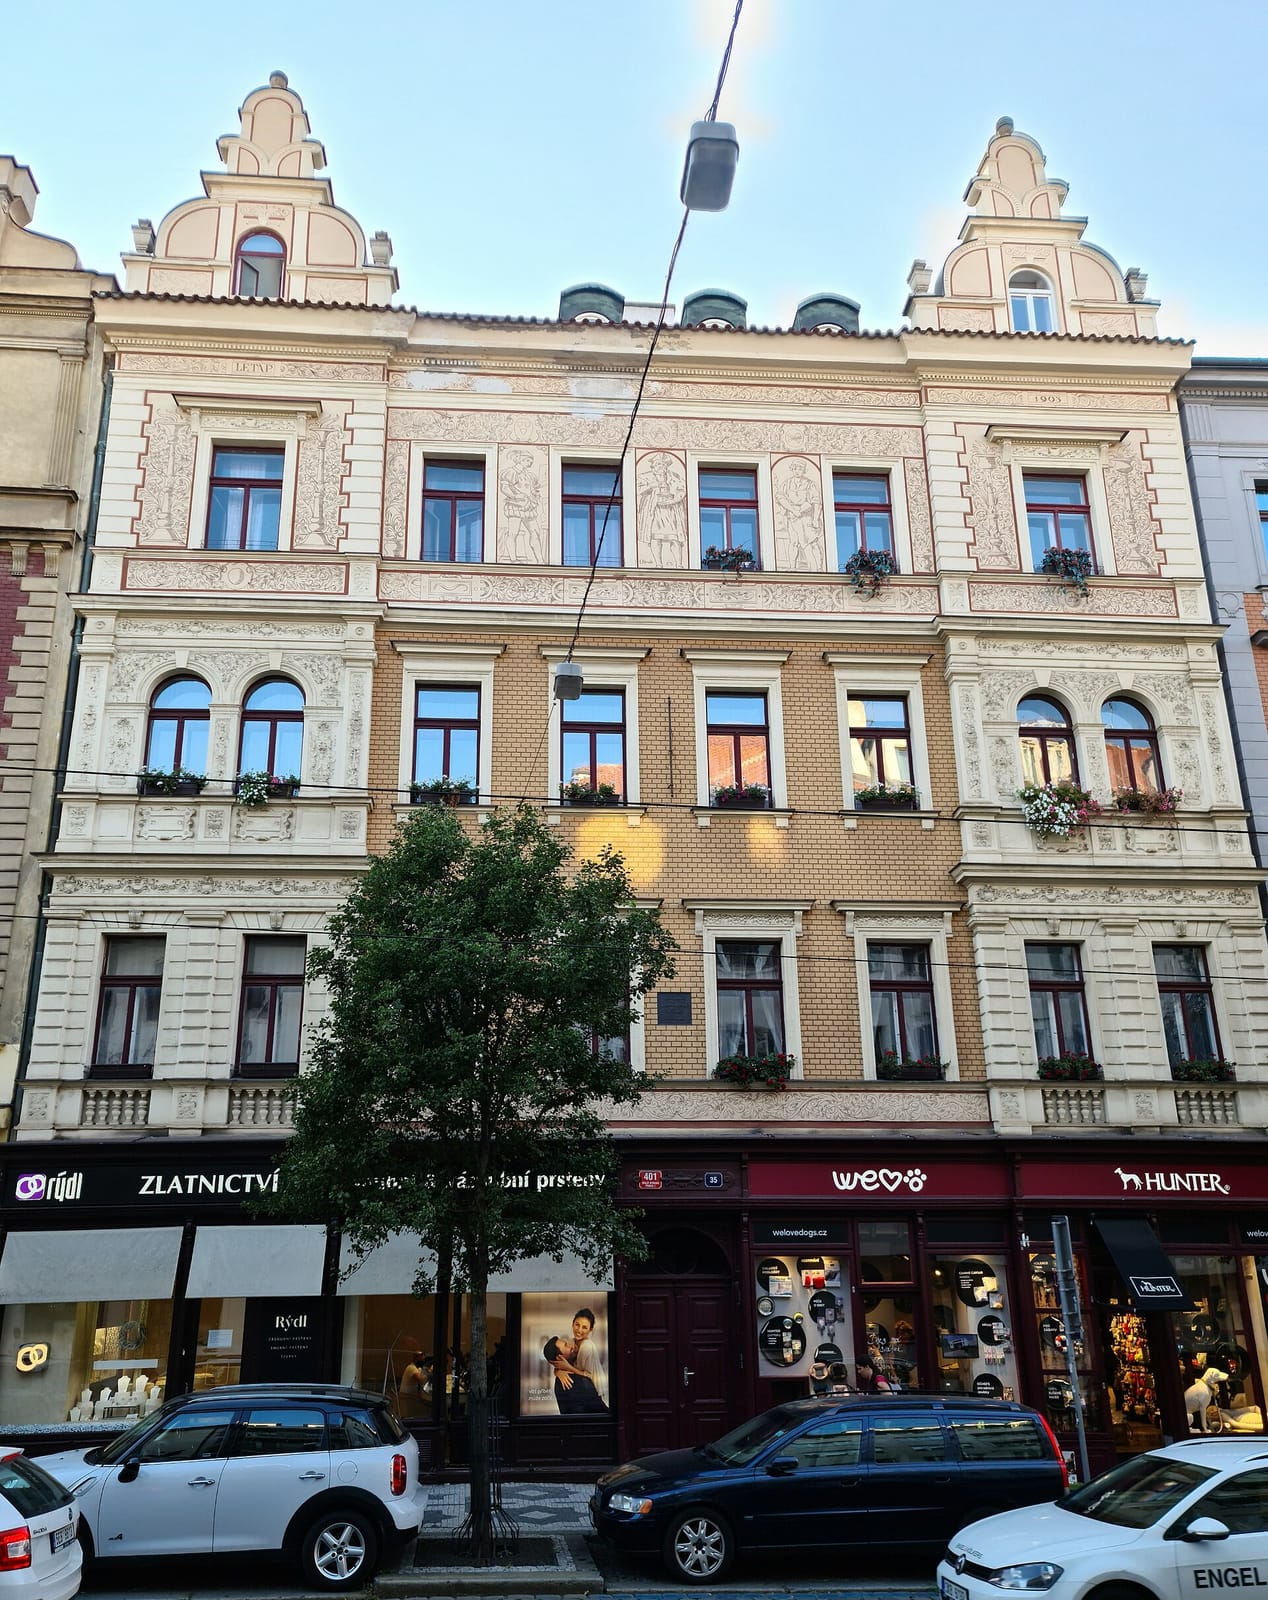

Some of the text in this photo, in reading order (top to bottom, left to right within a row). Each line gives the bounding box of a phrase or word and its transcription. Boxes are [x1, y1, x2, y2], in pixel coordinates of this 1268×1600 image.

[46, 1170, 83, 1202] rýdl
[138, 1167, 281, 1195] ZLATNICTVÍ
[643, 1172, 657, 1181] 401
[709, 1176, 718, 1184] 35
[1144, 1172, 1229, 1195] HUNTER
[772, 1228, 828, 1238] welovedogs.cz
[275, 1314, 307, 1332] Rýdl
[1193, 1566, 1268, 1589] ENGEL
